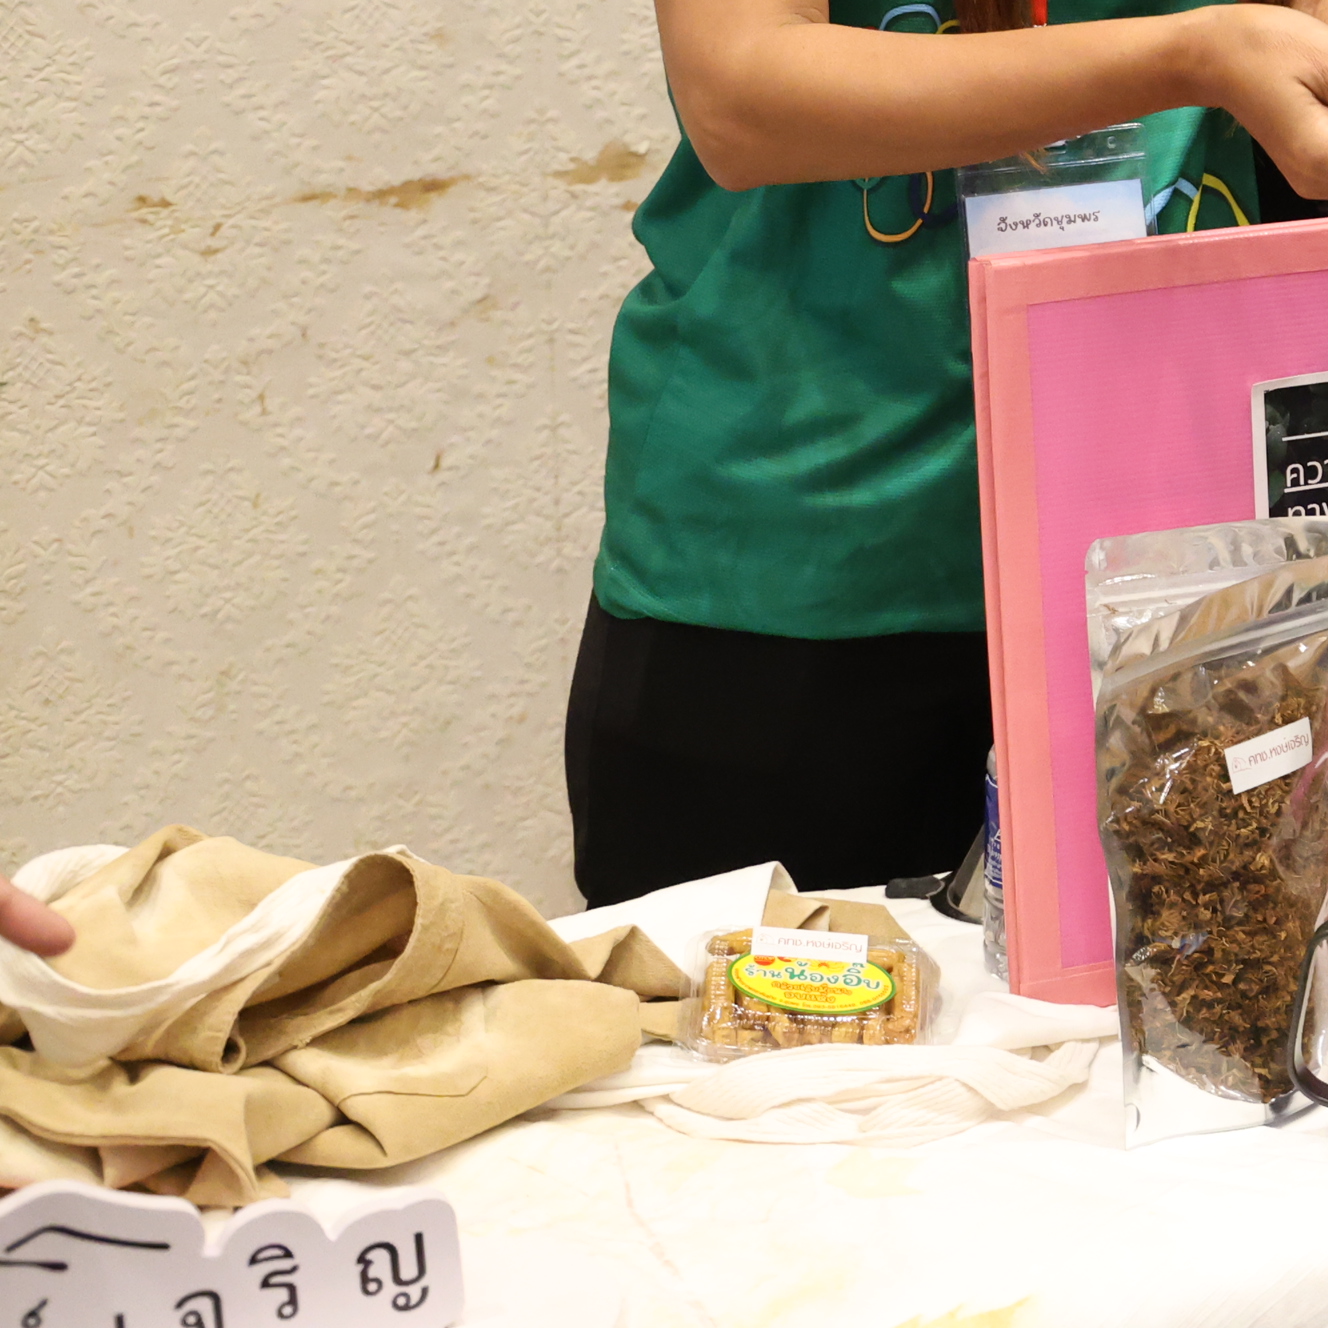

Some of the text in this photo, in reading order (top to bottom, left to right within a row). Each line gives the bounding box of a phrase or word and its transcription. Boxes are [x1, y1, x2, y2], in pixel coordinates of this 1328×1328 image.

[996, 210, 1100, 232] จังหวัดชุมพร
